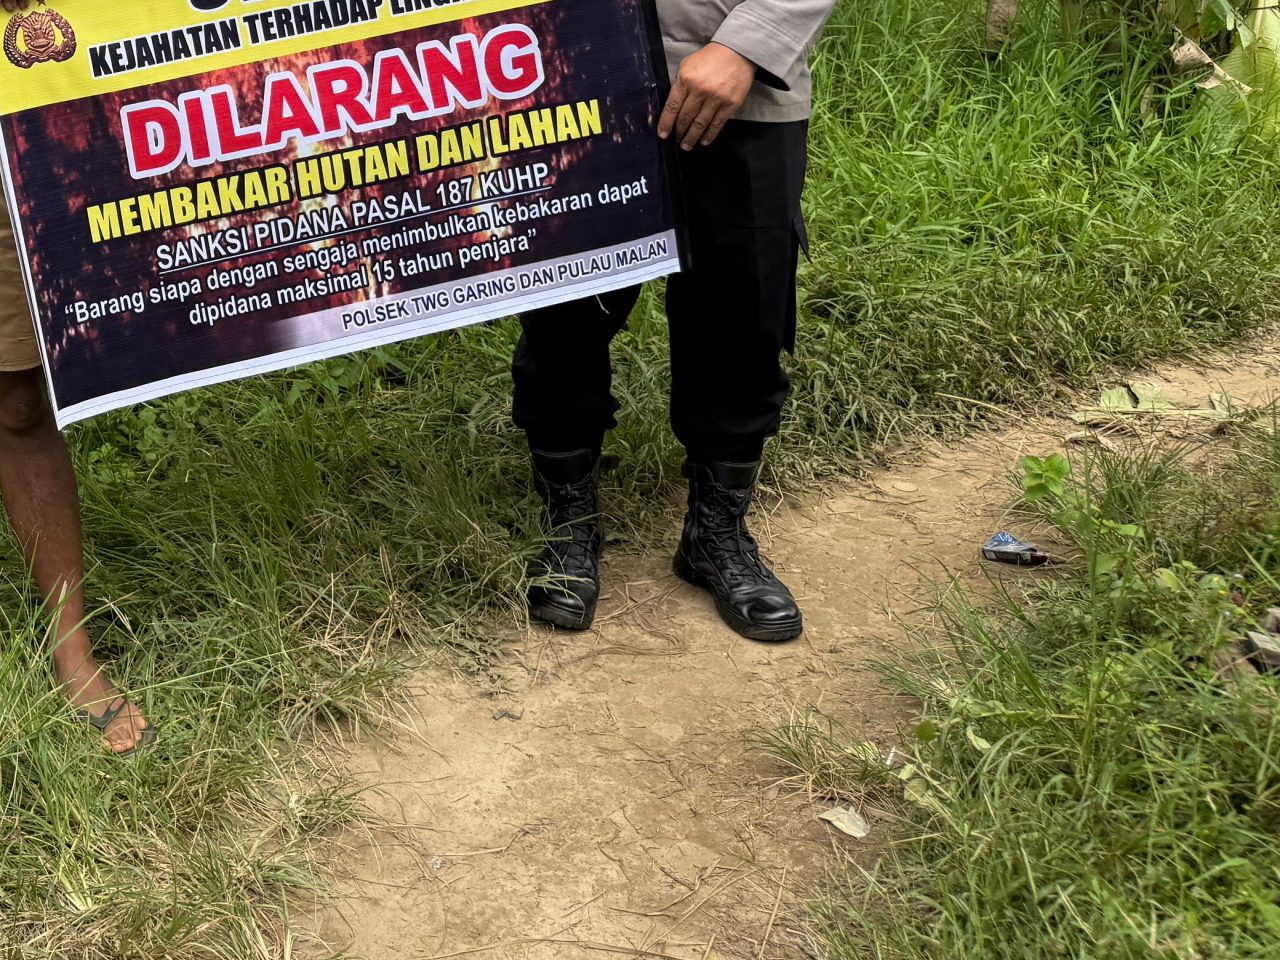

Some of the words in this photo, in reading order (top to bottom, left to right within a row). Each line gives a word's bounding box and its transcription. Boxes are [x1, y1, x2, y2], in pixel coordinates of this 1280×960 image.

[88, 18, 242, 78] KEJAHATAN
[123, 27, 542, 176] DILARANG
[86, 166, 291, 244] MEMBAKAR
[296, 147, 410, 199] HUTAN
[416, 120, 485, 168] DAN
[488, 98, 603, 154] LAHAN
[156, 229, 249, 271] SANKSI
[253, 206, 348, 248] PIDANA
[352, 189, 431, 226] PASAL
[436, 176, 473, 208] 187
[480, 162, 549, 198] KUHP
[64, 291, 145, 323] “Barang
[149, 277, 202, 304] siapa
[206, 261, 278, 291] dengan
[283, 240, 358, 273] sengaja
[362, 211, 490, 256] menimbulkan
[492, 192, 593, 227] kebakaran
[597, 175, 649, 205] dapat
[188, 292, 272, 327] dipidana
[276, 263, 369, 305] maksimal
[372, 259, 395, 283] 15
[398, 251, 454, 276] tahun
[458, 228, 537, 269] penjara”
[341, 300, 410, 330] POLSEK
[410, 291, 450, 315] TWG
[453, 276, 516, 305] GARING
[519, 266, 555, 290] DAN
[558, 256, 612, 281] PULAU
[615, 239, 668, 269] MALAN
